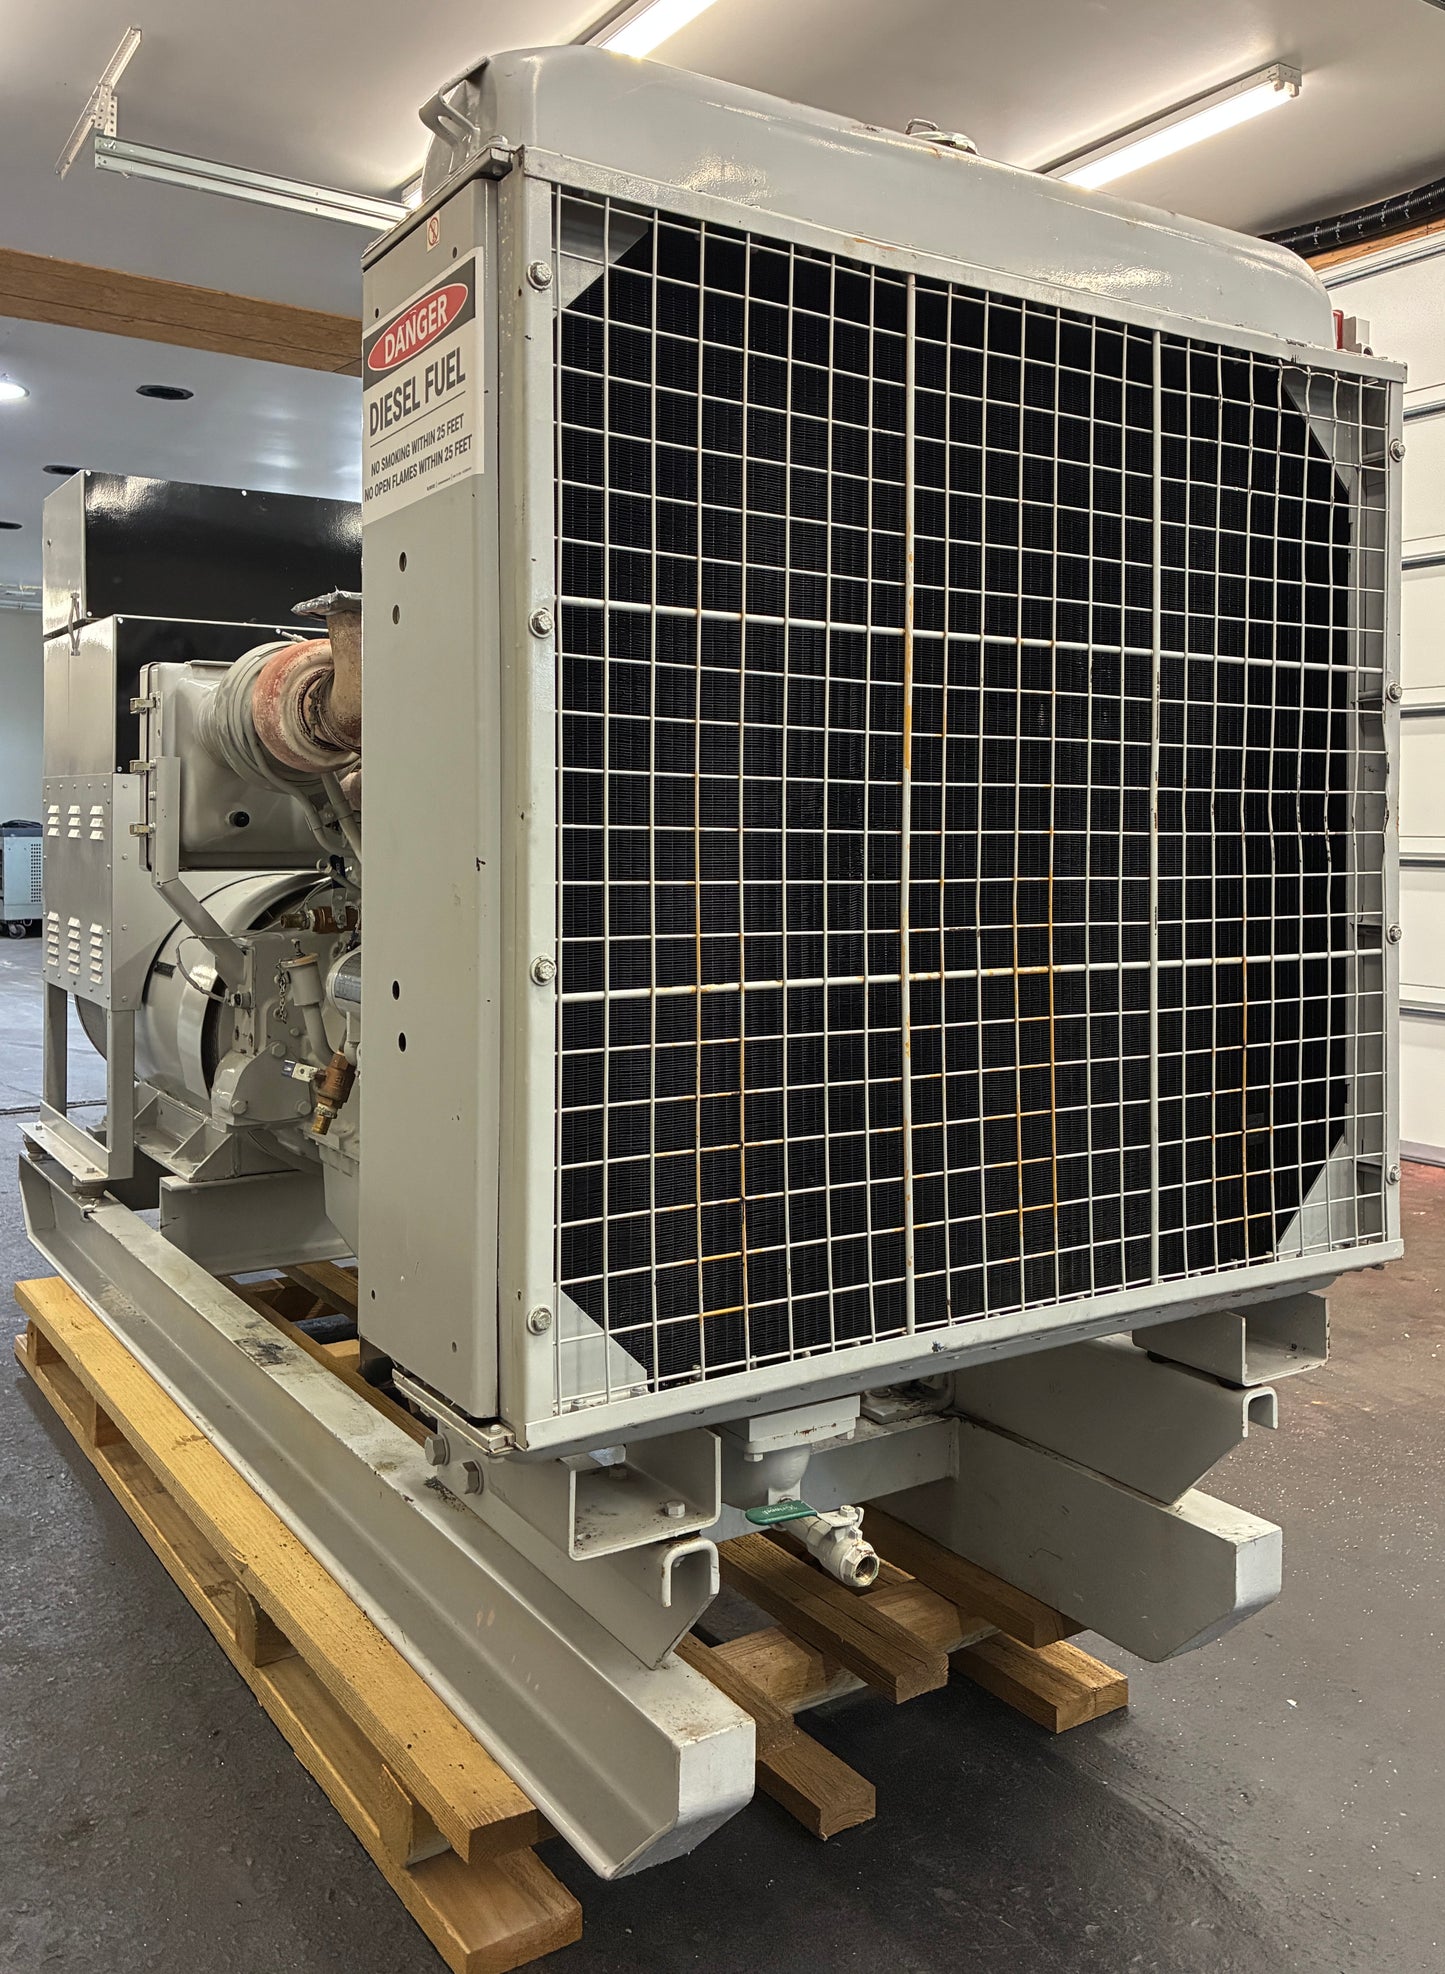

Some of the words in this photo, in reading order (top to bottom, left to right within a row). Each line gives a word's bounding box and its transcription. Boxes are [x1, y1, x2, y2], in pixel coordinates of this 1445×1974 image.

[384, 294, 447, 364] DANGER
[370, 376, 420, 436] DIESEL
[425, 347, 466, 404] FUEL
[364, 486, 373, 502] NO
[374, 477, 391, 497] OPEN
[392, 463, 417, 488] FLAMES
[418, 449, 443, 475] WITHIN
[444, 444, 453, 462] 25
[454, 434, 472, 456] FEET
[371, 460, 380, 477] NO
[381, 443, 410, 471] SMOKING
[411, 429, 435, 455] WITHIN
[436, 423, 445, 441] 25
[446, 413, 464, 436] FEET
